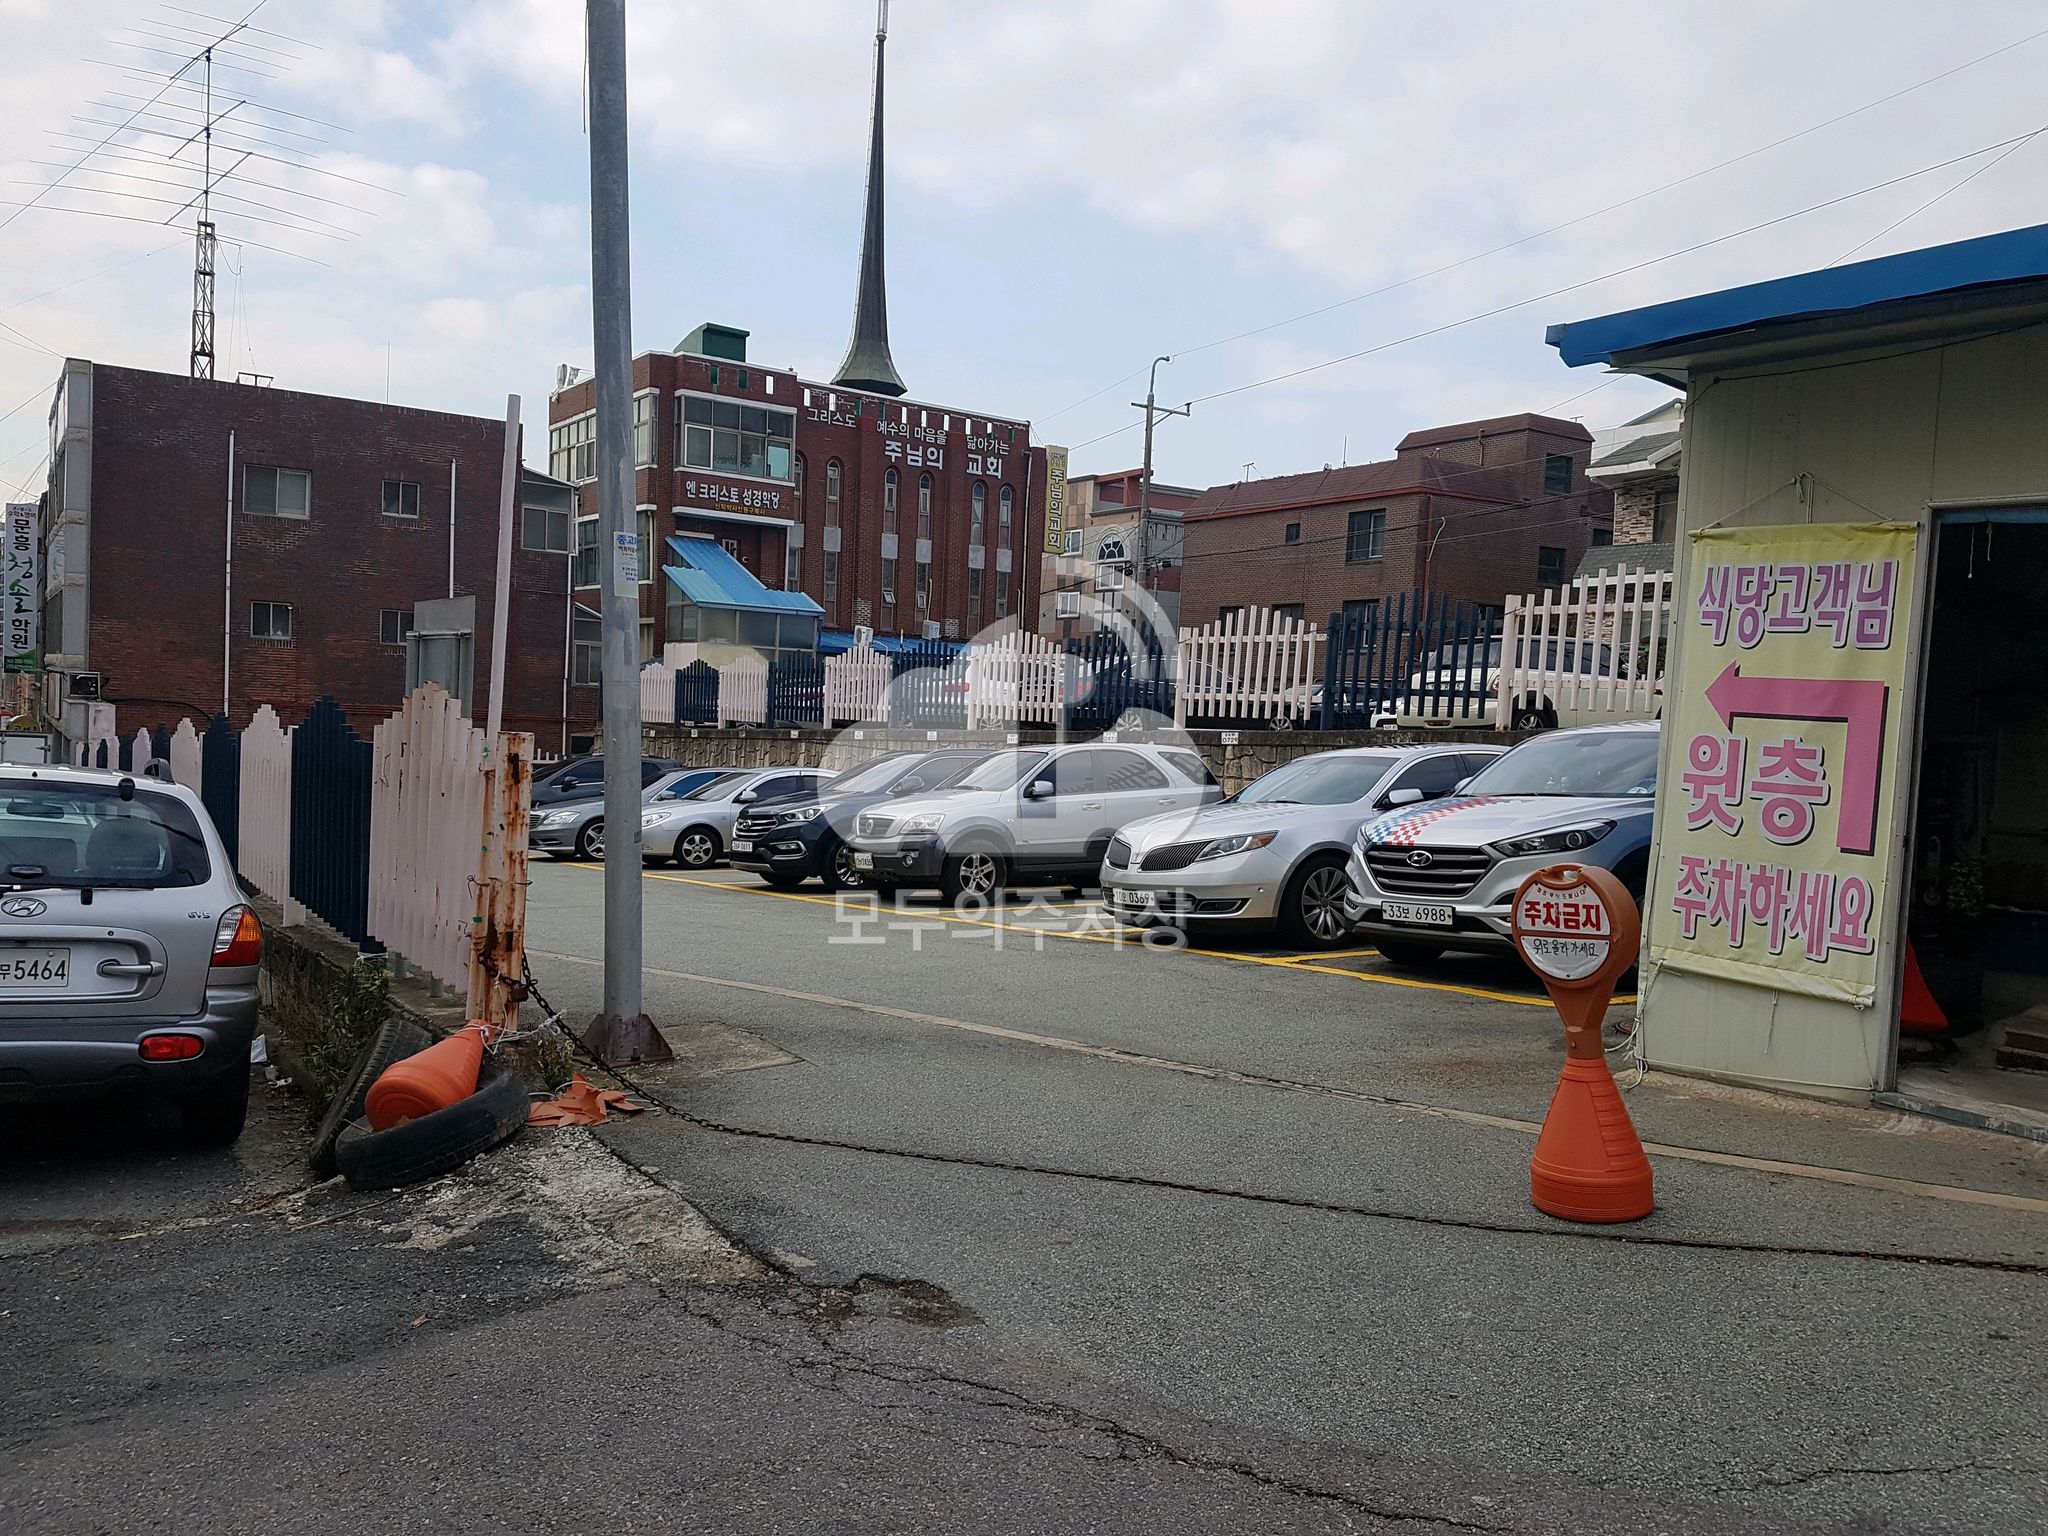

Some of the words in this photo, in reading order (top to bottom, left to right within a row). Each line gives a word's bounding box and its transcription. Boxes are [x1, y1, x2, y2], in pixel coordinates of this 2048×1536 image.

[807, 408, 856, 427] 그리스도
[876, 420, 910, 438] 예수의
[914, 427, 947, 445] 마음을
[966, 435, 1009, 455] 닮아가는
[885, 440, 943, 470] 주님의
[966, 453, 1002, 478] 교회
[686, 480, 696, 498] 엔
[699, 483, 740, 503] 크리스토
[743, 488, 780, 509] 성경학당
[1048, 468, 1065, 548] 주님의교회
[1698, 560, 1898, 647] 식당고객님
[1682, 733, 1829, 845] 윗층
[1128, 892, 1150, 904] 0369
[1415, 906, 1447, 922] 6988
[1524, 900, 1602, 932] 주차금지
[1673, 854, 1874, 961] 주차하세요
